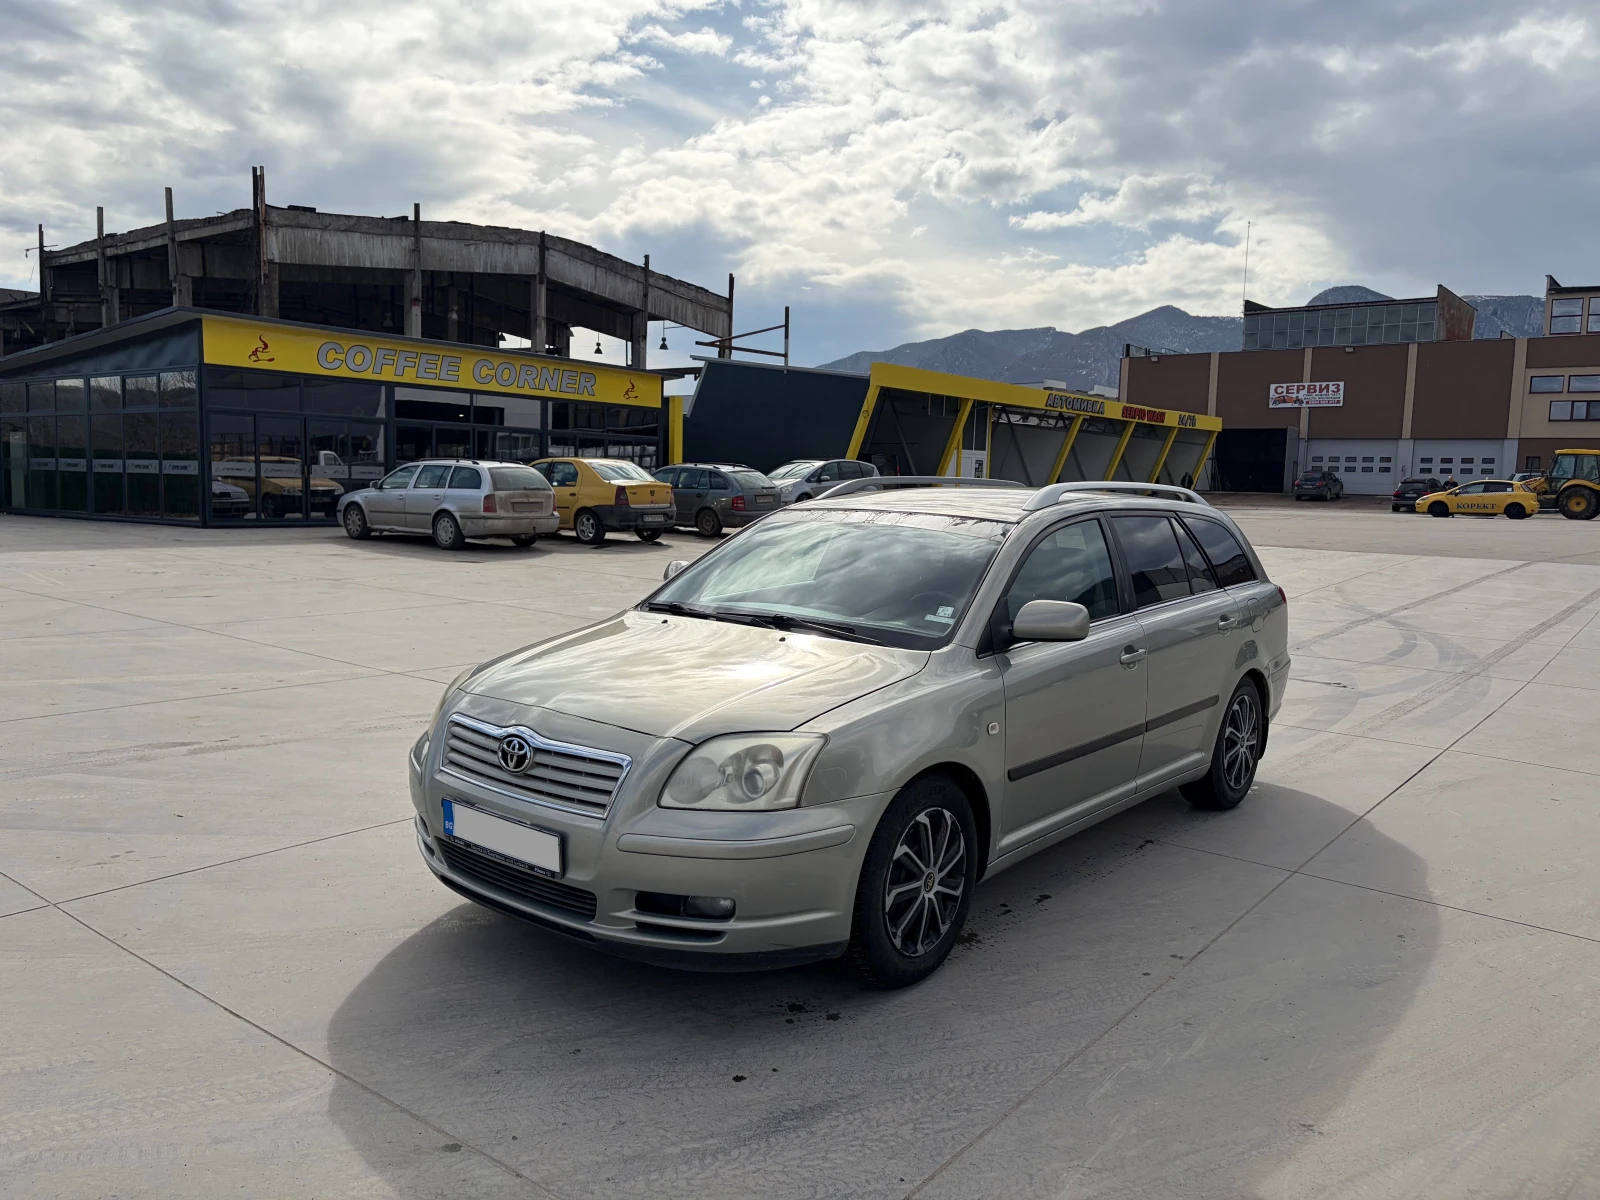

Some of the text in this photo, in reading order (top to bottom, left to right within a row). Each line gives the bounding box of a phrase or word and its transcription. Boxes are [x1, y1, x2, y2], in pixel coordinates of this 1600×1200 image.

[317, 341, 597, 396] COFFEE CORNER
[1274, 383, 1341, 395] СЕРВИЗ
[1046, 393, 1105, 415] АВТОМИВКА
[1146, 409, 1166, 424] WASH
[1456, 502, 1497, 510] КОРЕКТ
[445, 820, 453, 830] BG
